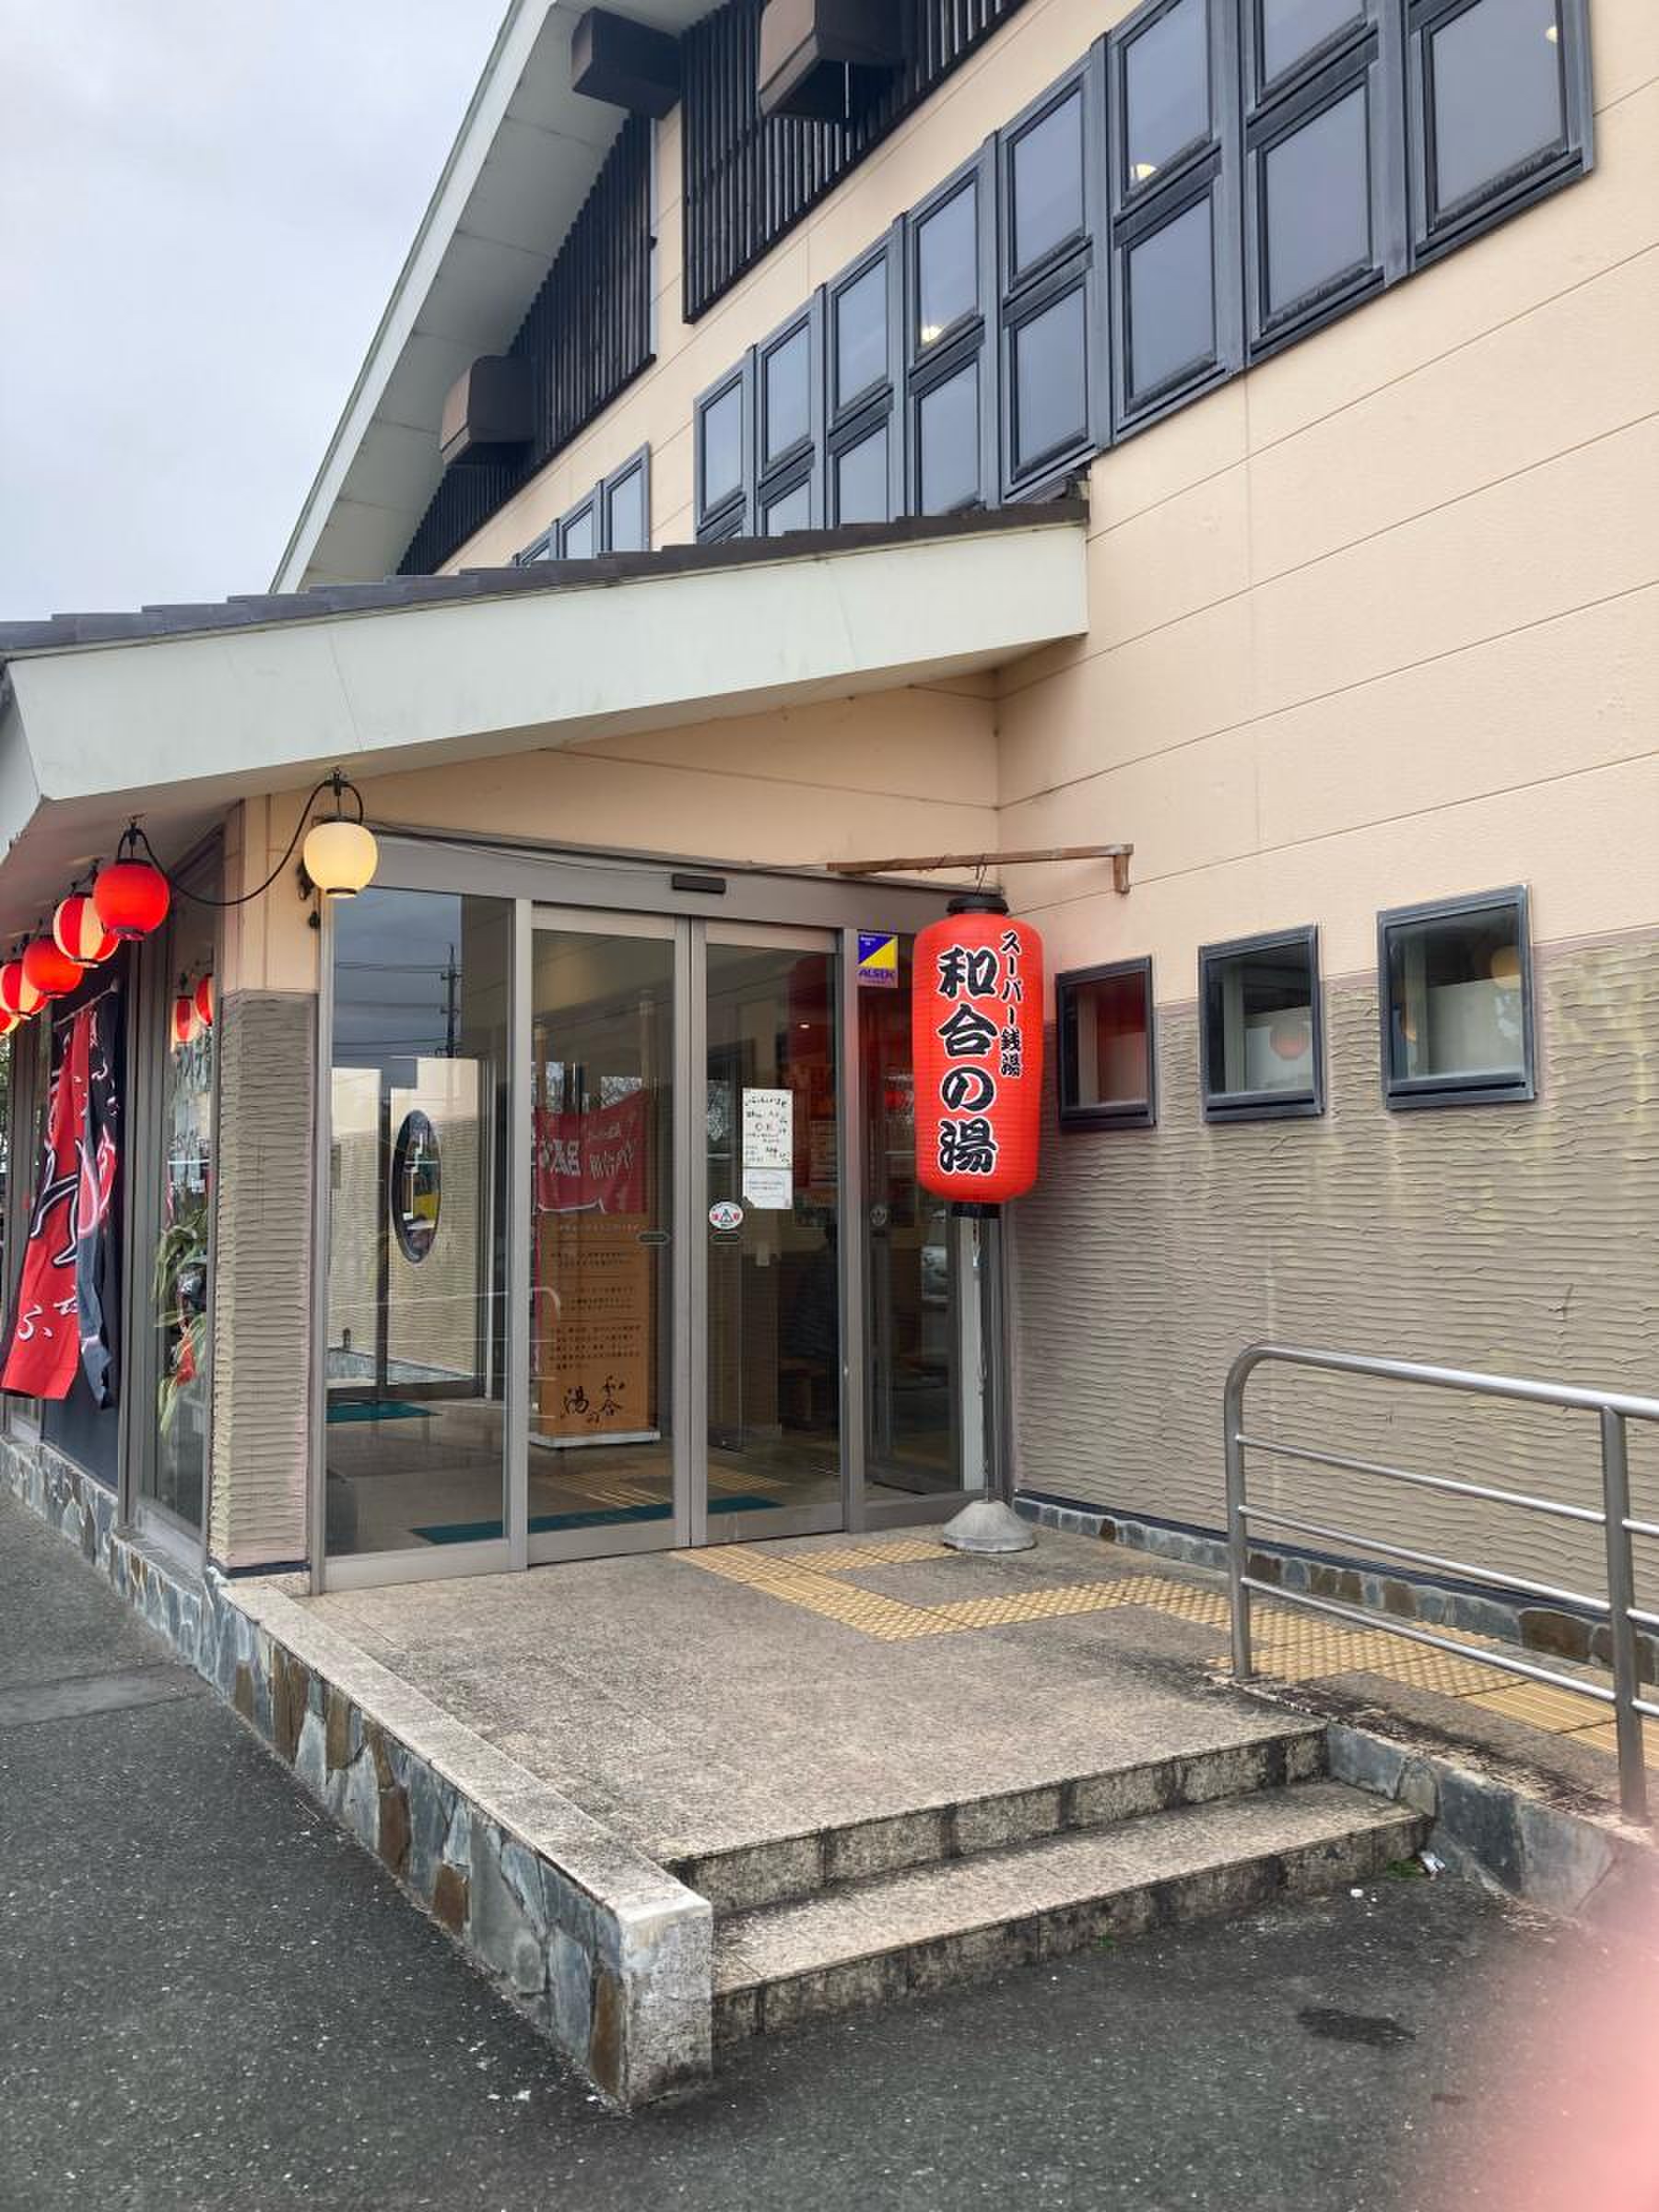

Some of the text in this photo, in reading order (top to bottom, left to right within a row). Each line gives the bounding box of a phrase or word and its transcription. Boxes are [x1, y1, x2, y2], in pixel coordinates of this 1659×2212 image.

[937, 944, 998, 1175] 和合の湯
[1001, 930, 1022, 1077] スーパー銭湯
